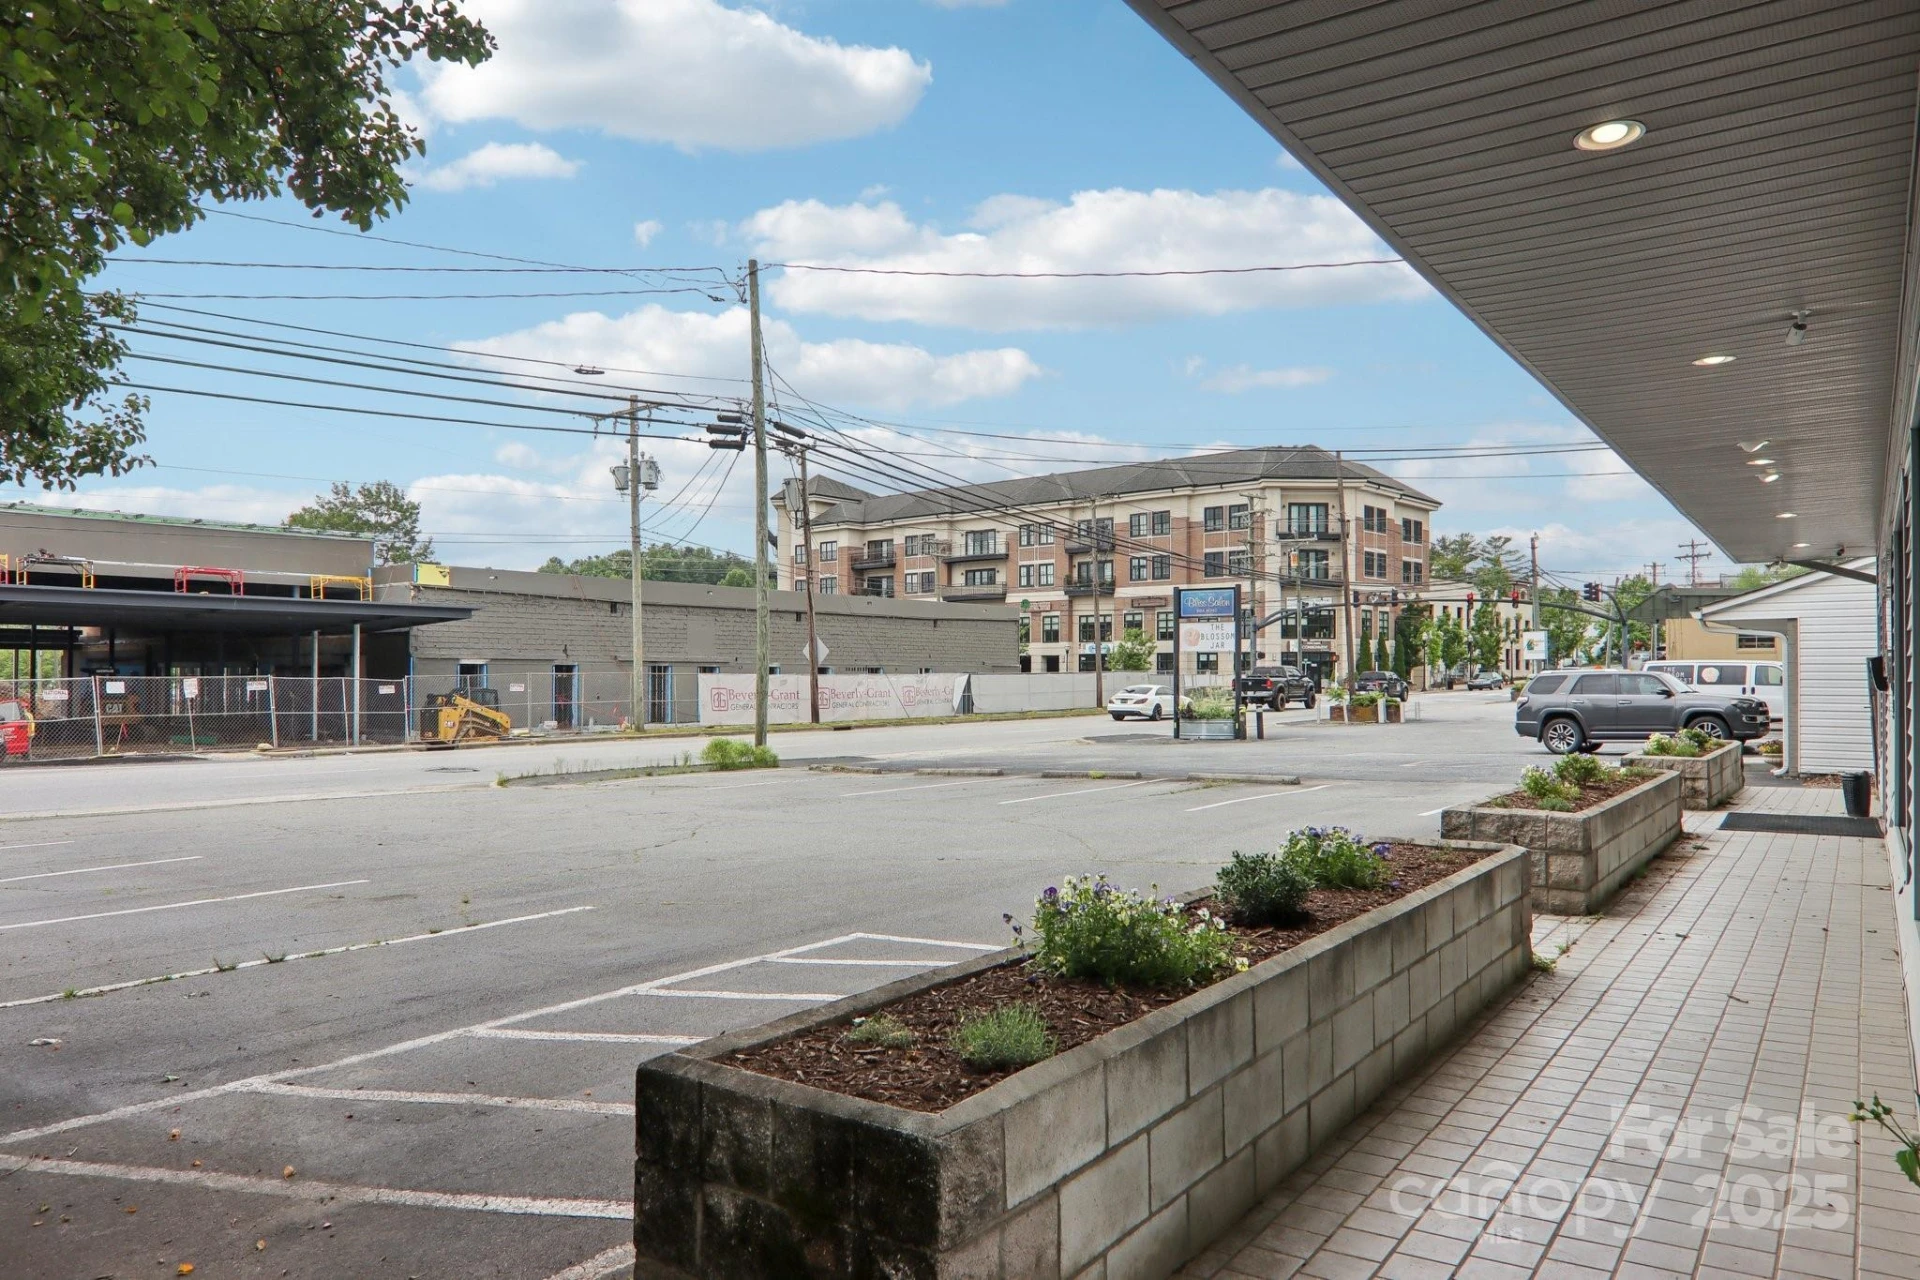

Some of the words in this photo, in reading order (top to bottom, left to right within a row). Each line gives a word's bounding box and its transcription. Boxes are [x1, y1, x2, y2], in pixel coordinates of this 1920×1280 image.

[1208, 596, 1230, 607] Salon
[830, 687, 891, 701] Beverly-Grant
[106, 704, 122, 713] CAT
